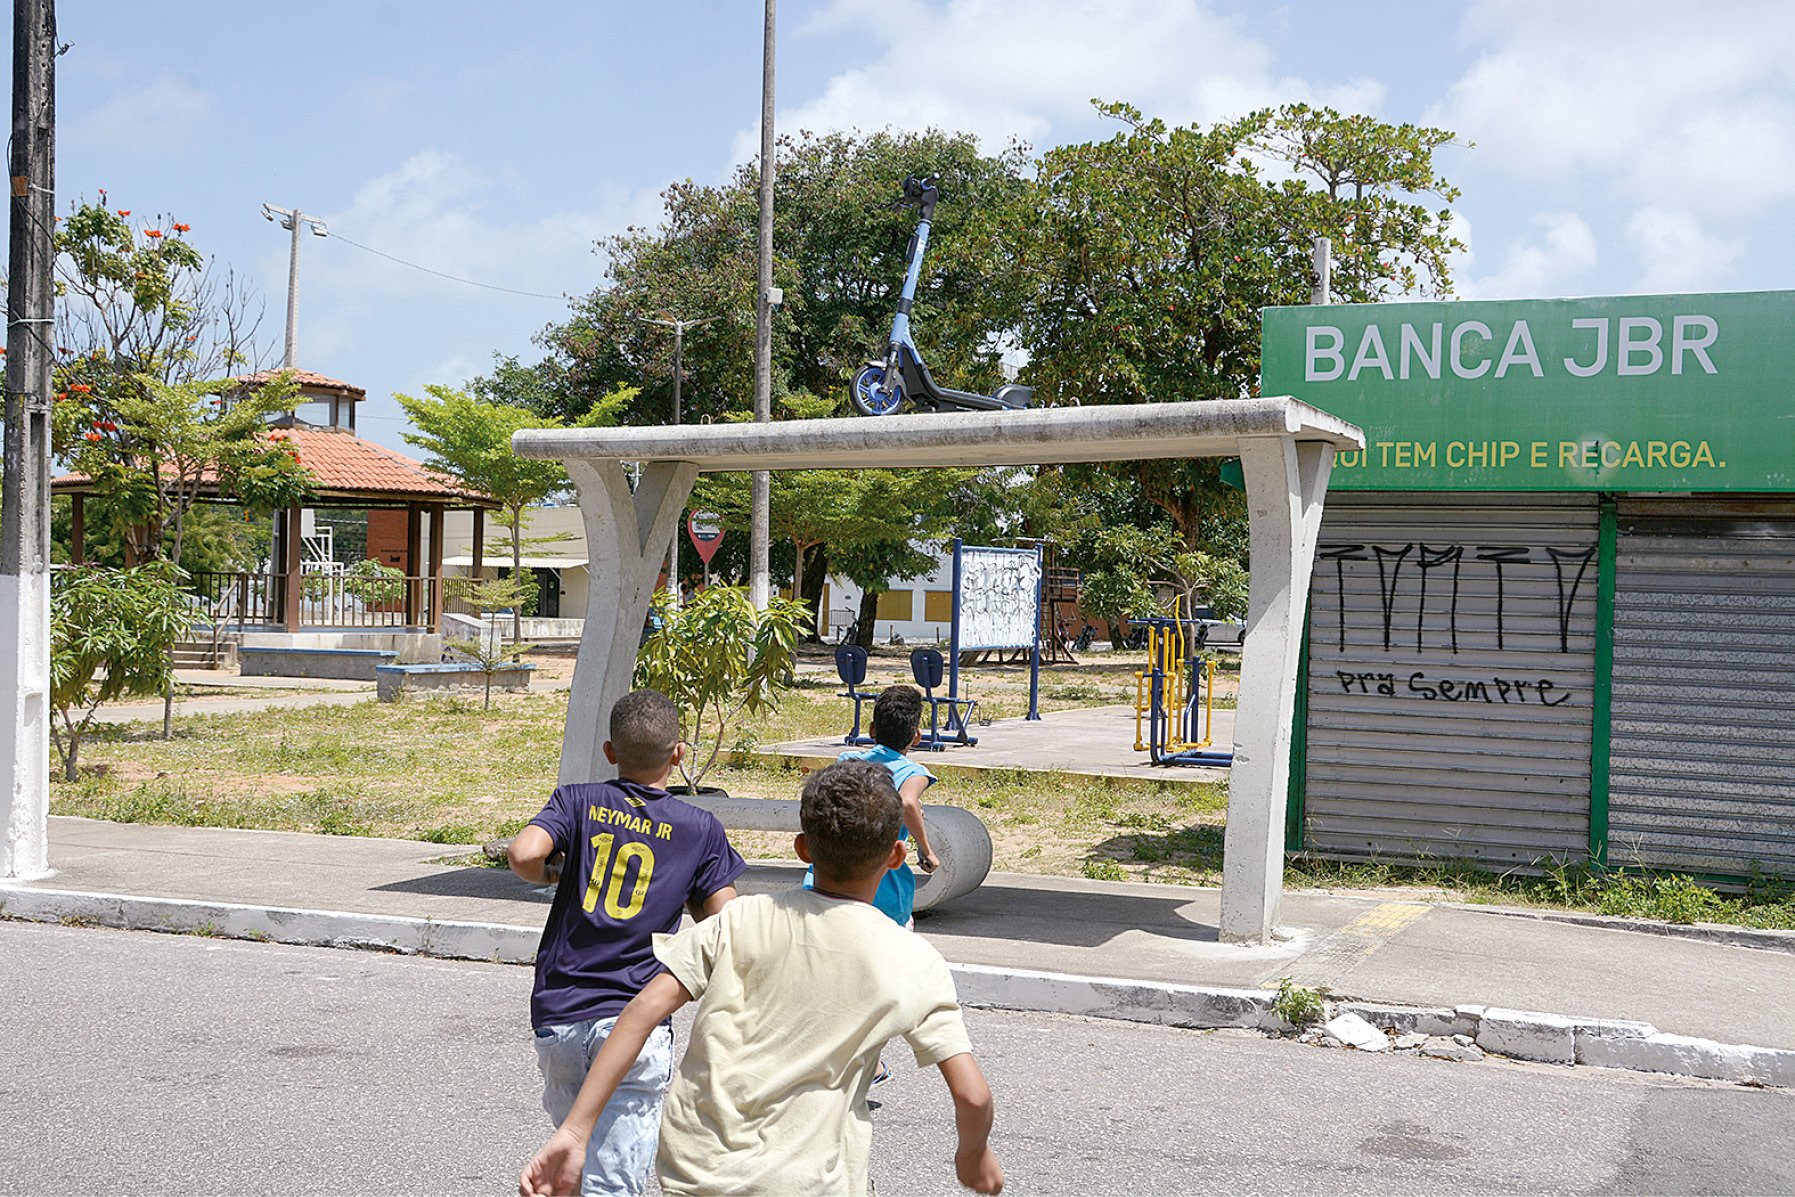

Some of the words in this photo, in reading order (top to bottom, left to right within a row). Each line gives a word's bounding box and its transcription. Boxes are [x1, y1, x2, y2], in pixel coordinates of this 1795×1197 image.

[1304, 320, 1545, 382] BANCA
[1563, 315, 1720, 376] JBR
[1333, 449, 1368, 469] UI
[1376, 441, 1437, 468] TEM
[1445, 440, 1520, 468] CHIP
[1530, 440, 1548, 468] E
[1558, 439, 1727, 468] RECARGA.
[590, 806, 652, 834] NEYMAR
[655, 823, 673, 839] JR
[582, 832, 655, 920] 10
